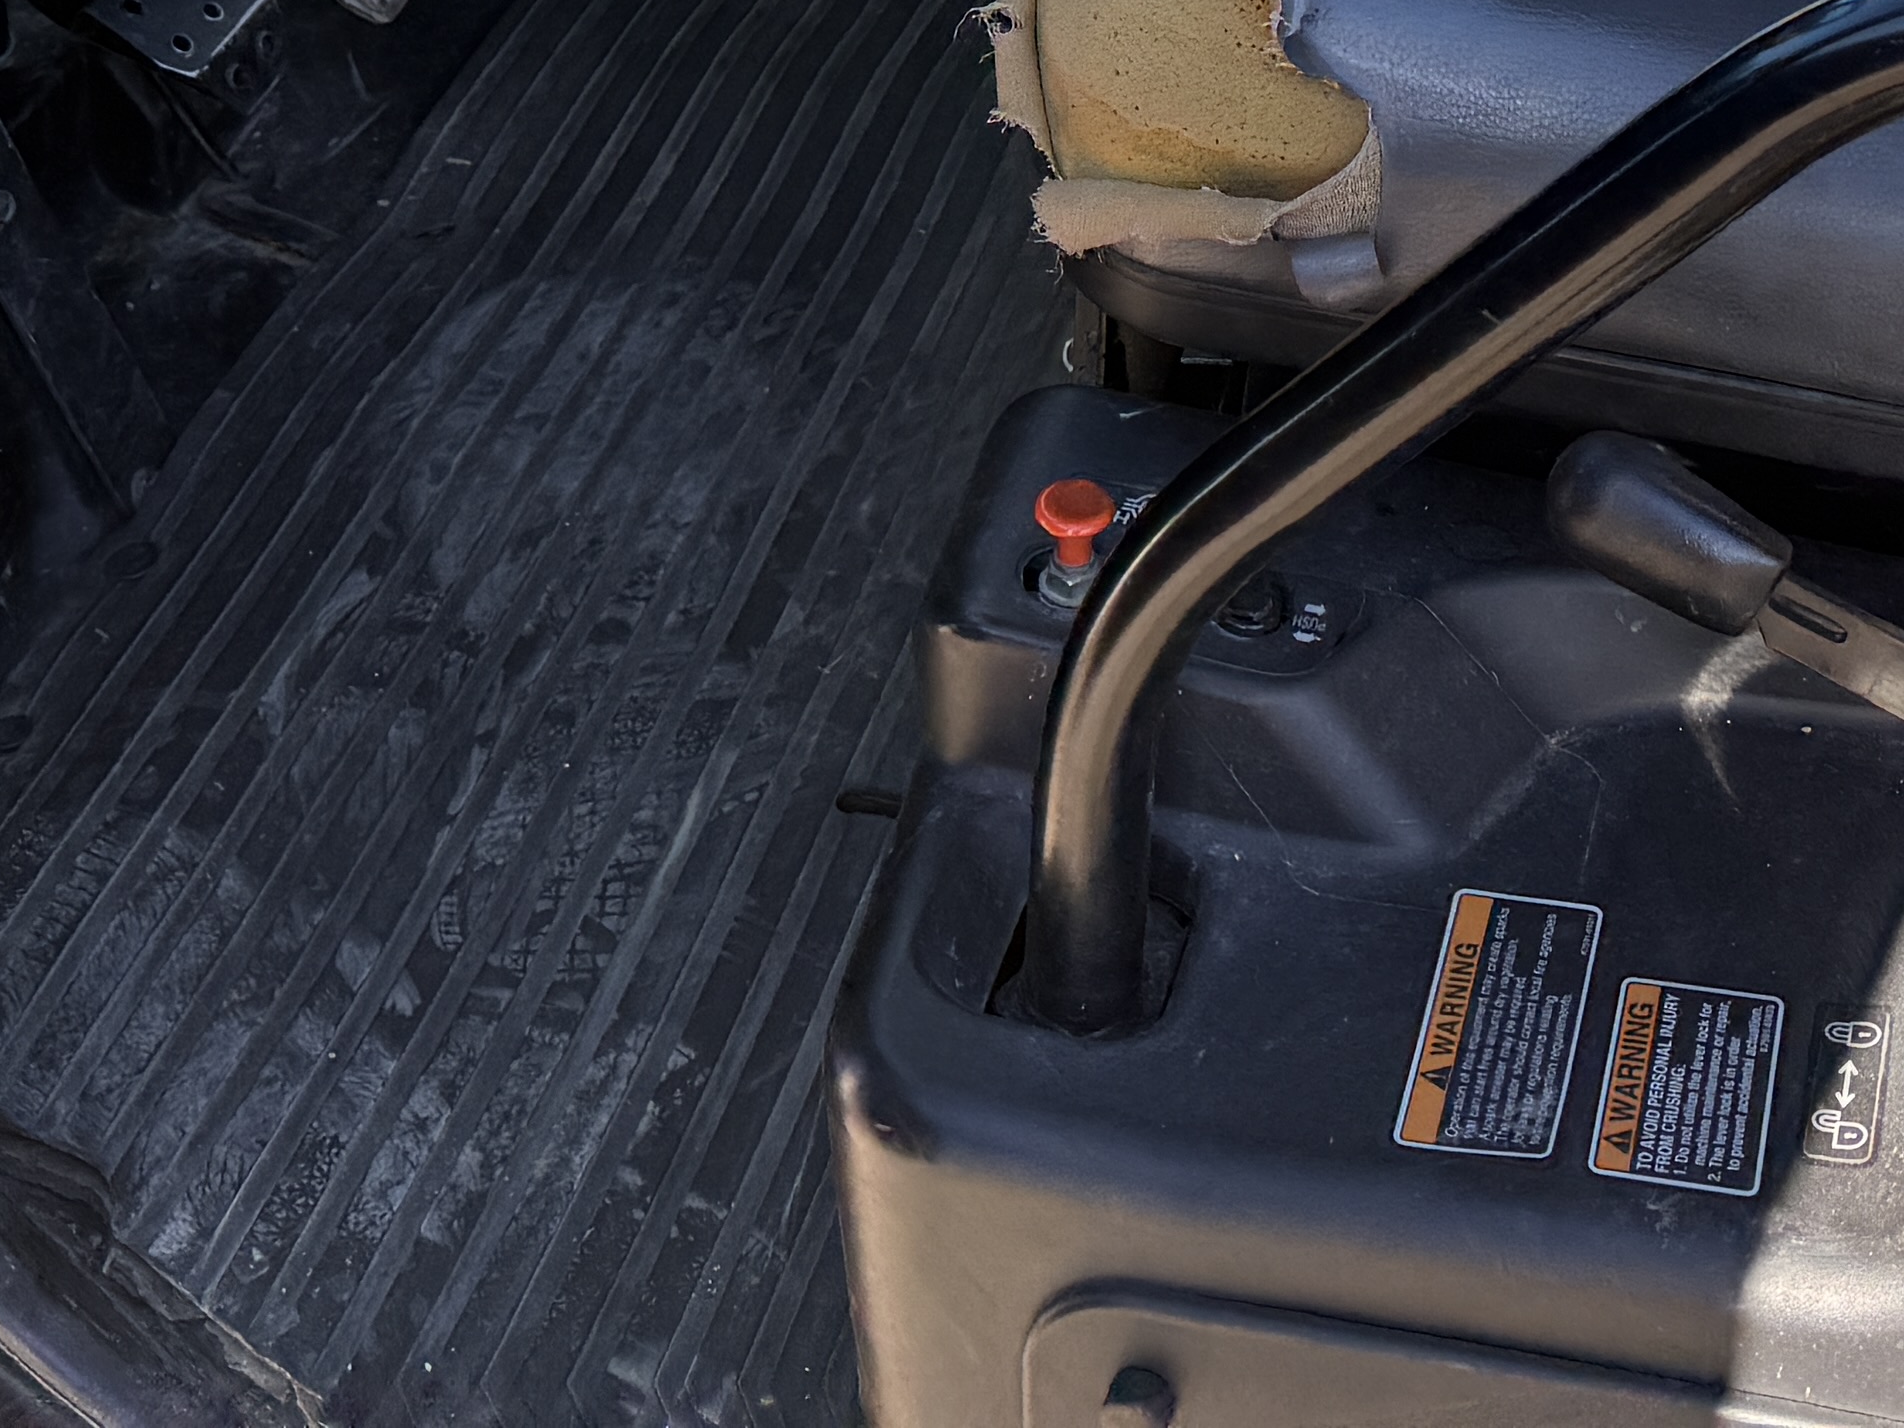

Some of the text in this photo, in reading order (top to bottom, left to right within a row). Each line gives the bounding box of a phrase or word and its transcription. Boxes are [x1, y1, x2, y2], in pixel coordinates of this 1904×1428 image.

[1428, 941, 1479, 1057] WARNING
[1658, 993, 1681, 1037] INJURY
[1694, 1018, 1711, 1042] lock
[1724, 1036, 1743, 1066] order
[1608, 1001, 1654, 1124] WARNING
[1646, 1038, 1673, 1107] PERSONAL
[1690, 1043, 1707, 1070] lever
[1653, 1062, 1687, 1173] FROM CRUSHING:
[1716, 1091, 1734, 1115] lock
[1639, 1108, 1661, 1150] AVOID
[1711, 1116, 1730, 1145] lever
